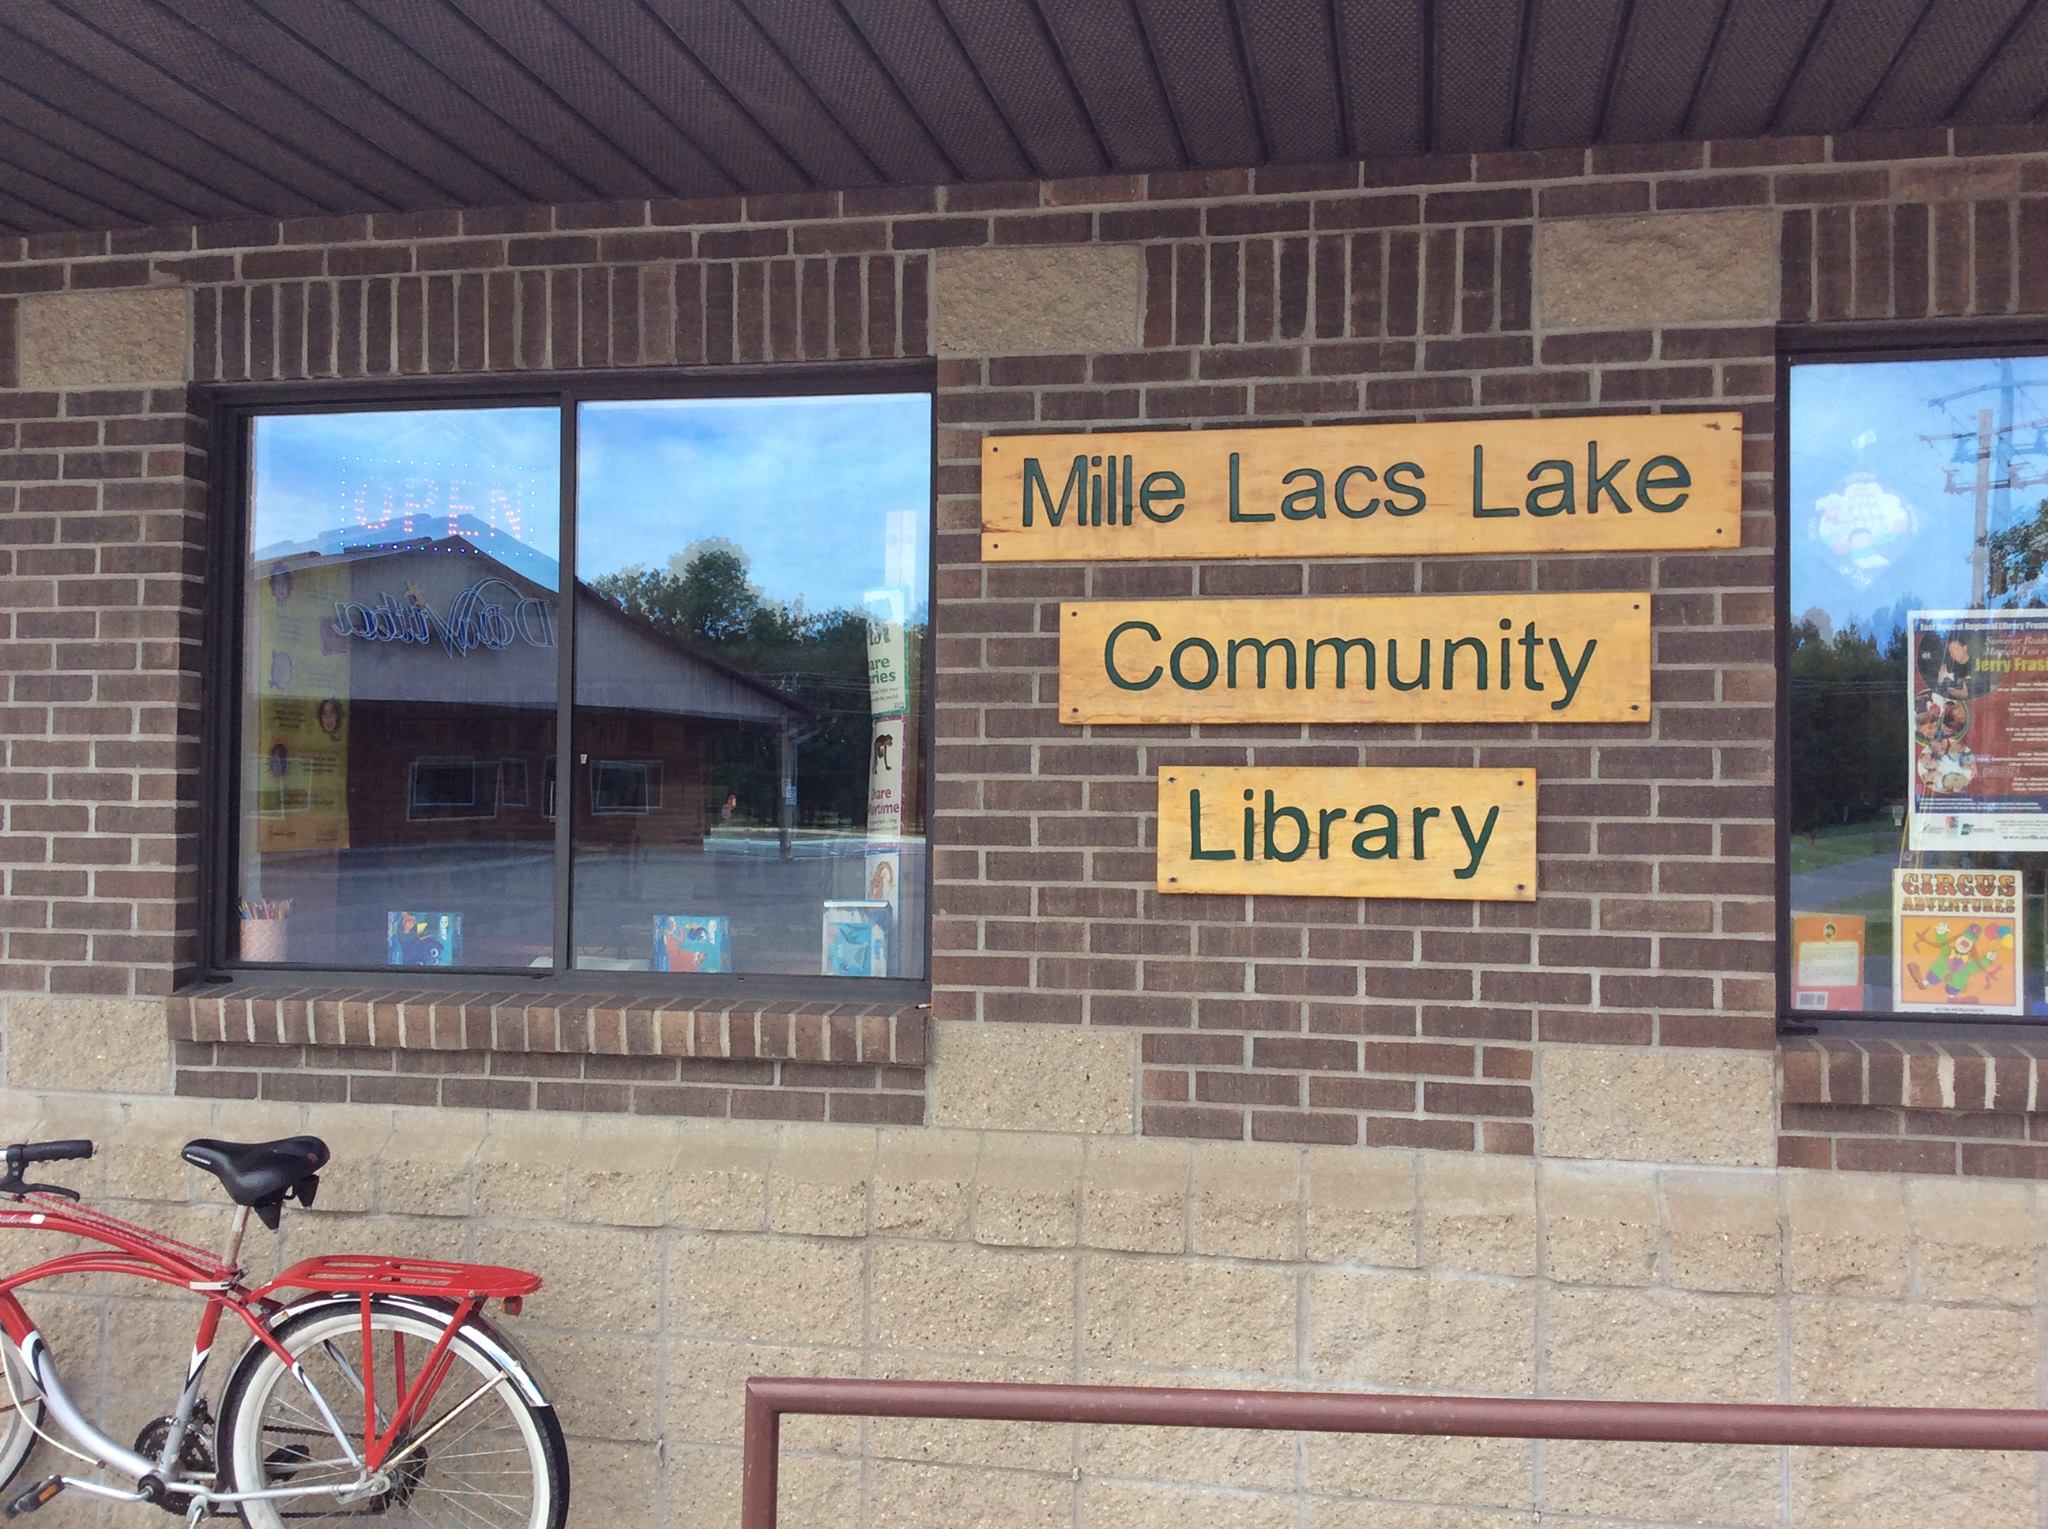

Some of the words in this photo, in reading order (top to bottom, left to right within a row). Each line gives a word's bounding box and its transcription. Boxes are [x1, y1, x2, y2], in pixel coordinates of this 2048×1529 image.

[1022, 455, 1186, 527] Mille
[1229, 452, 1426, 523] Lacs
[1473, 441, 1692, 518] Lake
[1104, 618, 1597, 710] Community
[1975, 657, 2011, 673] Jerry
[1188, 788, 1501, 880] Library
[1901, 872, 2016, 897] CIRCUS
[1901, 897, 2016, 914] ADVENTURES
